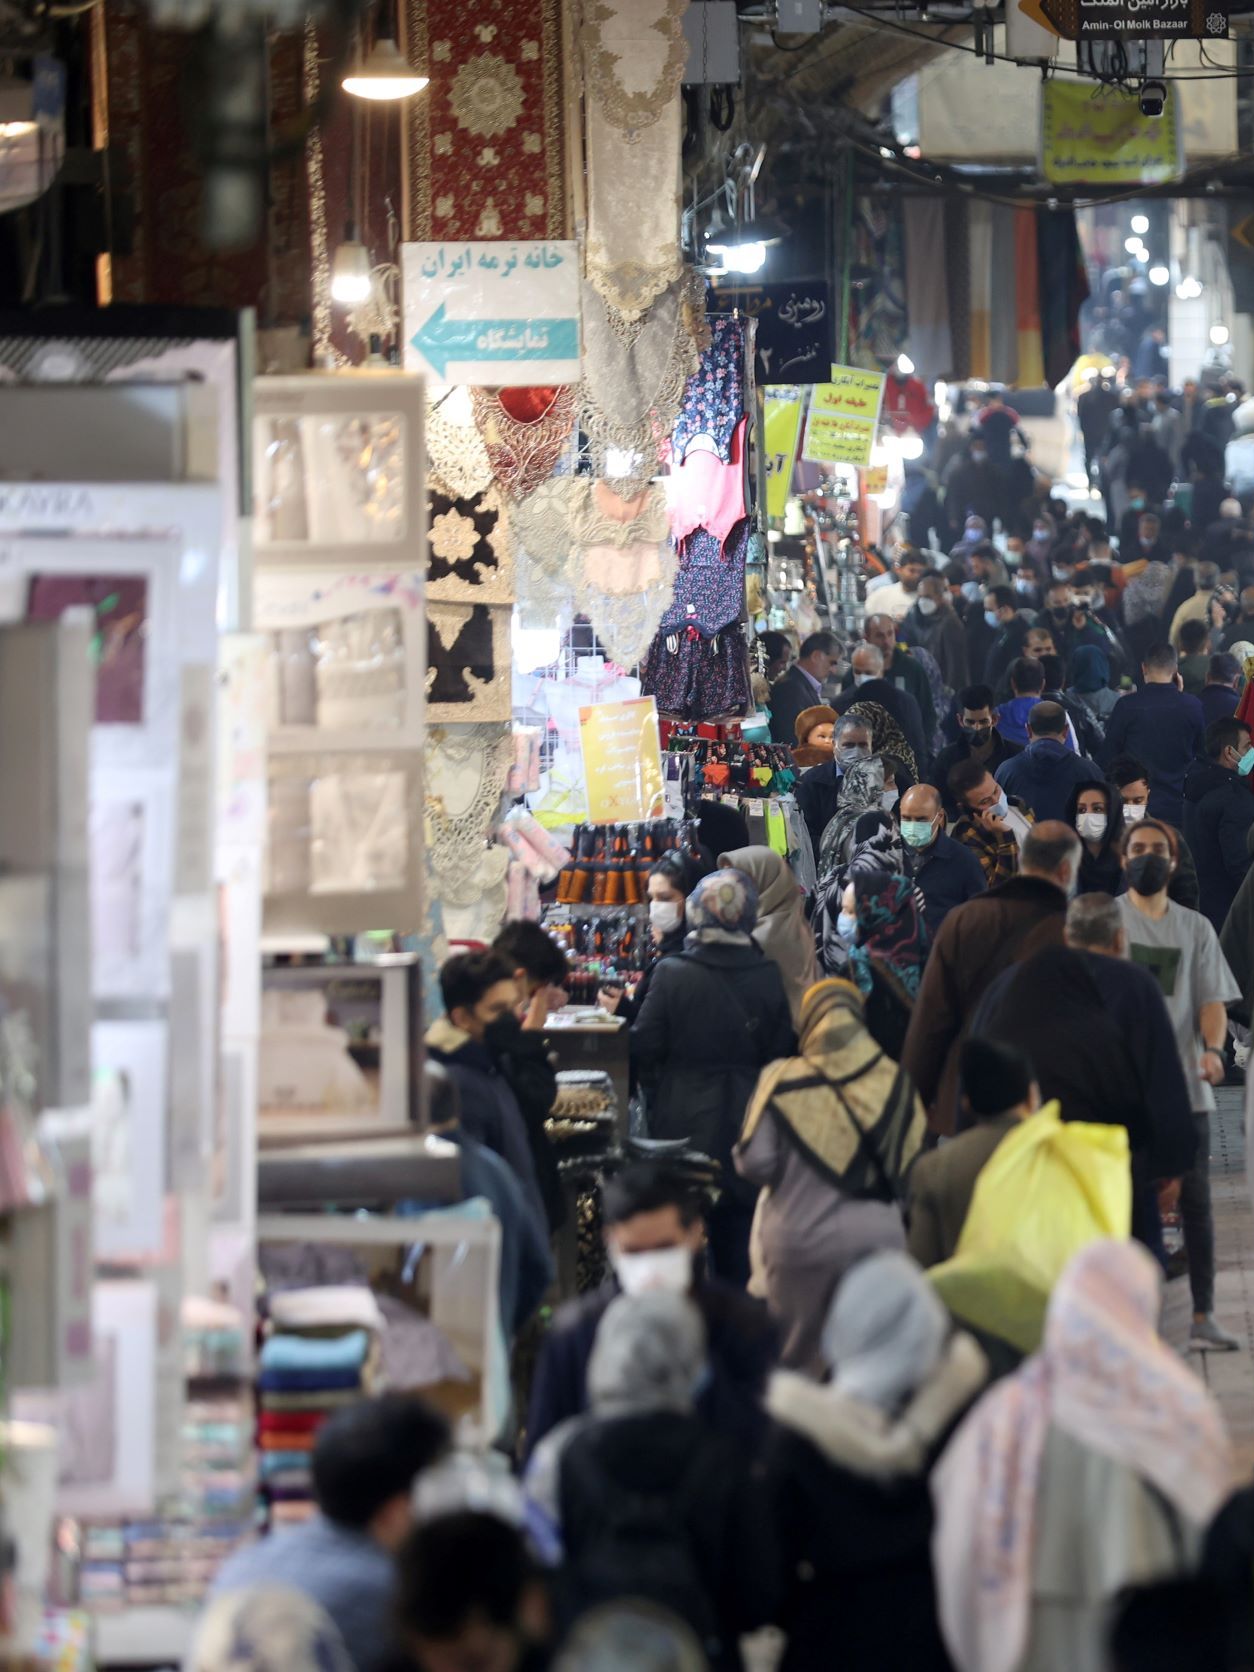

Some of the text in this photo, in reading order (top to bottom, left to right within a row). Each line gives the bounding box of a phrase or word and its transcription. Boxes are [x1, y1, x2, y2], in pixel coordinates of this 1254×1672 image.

[1126, 18, 1151, 29] Molk
[1152, 18, 1188, 29] Bazaar
[421, 245, 564, 278] خانه ترمه ایران
[476, 323, 549, 354] نمایشگاه
